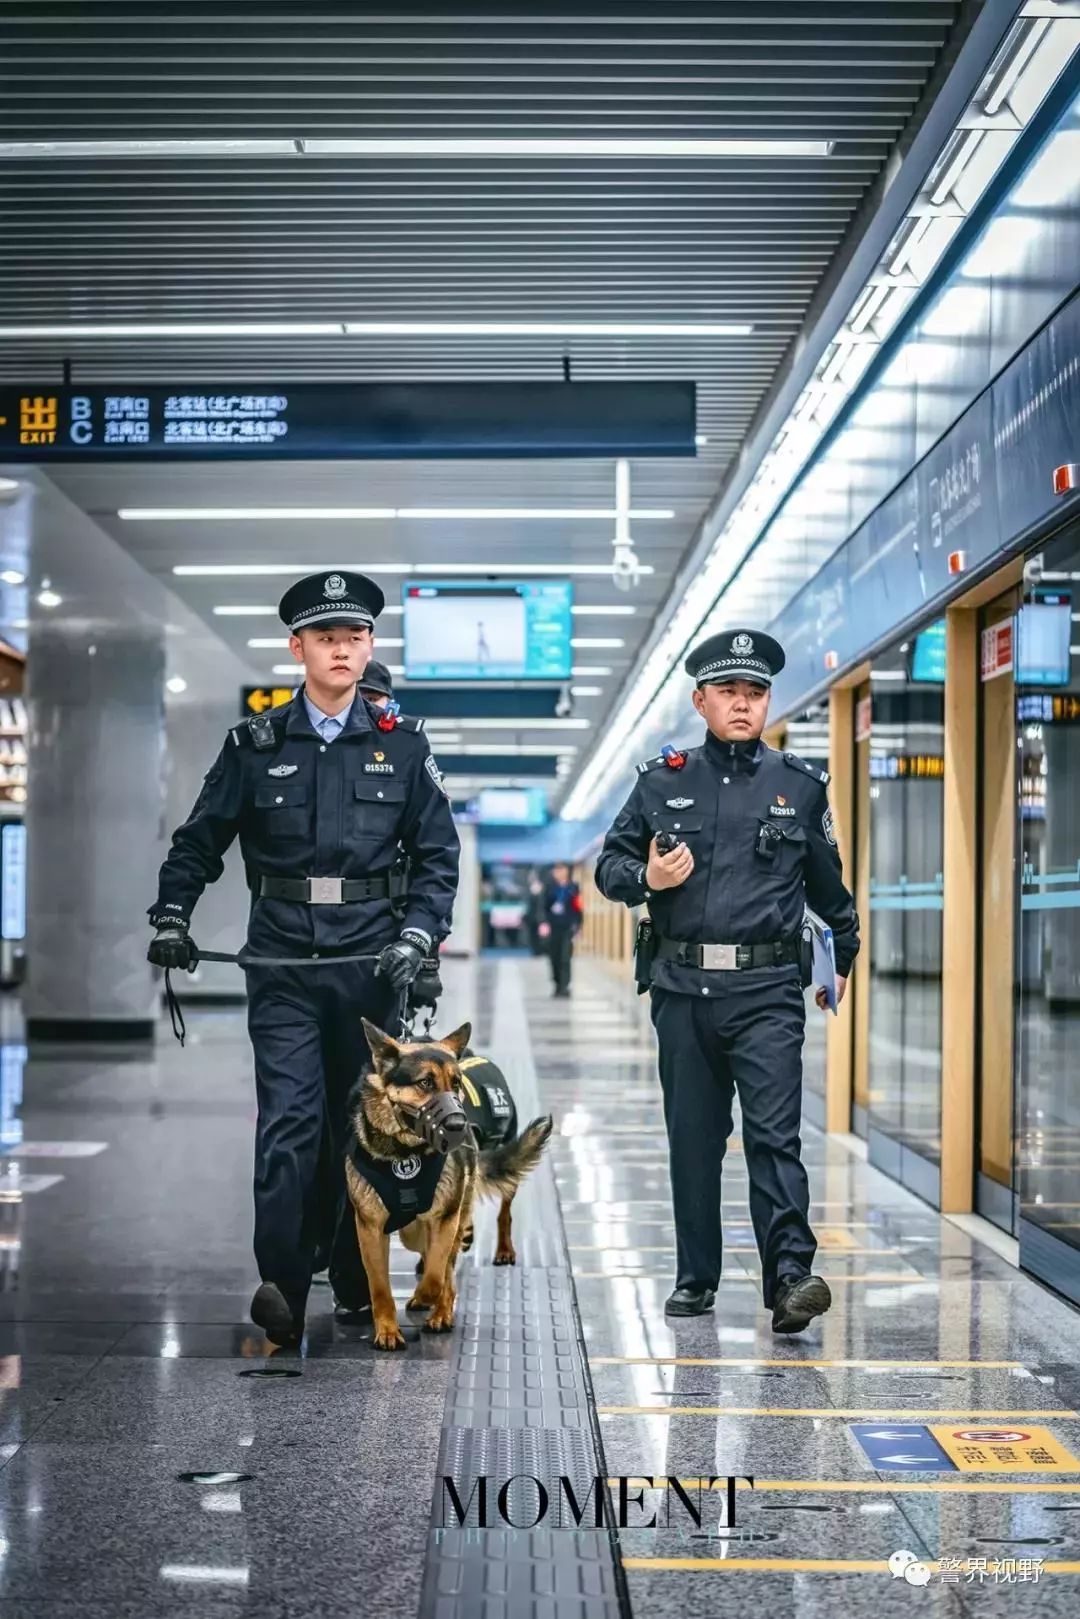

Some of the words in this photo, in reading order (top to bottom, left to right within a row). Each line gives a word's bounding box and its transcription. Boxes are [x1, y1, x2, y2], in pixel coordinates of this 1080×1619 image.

[20, 397, 57, 430] 出
[71, 397, 92, 420] B
[20, 432, 56, 443] EXIT
[70, 421, 93, 444] C
